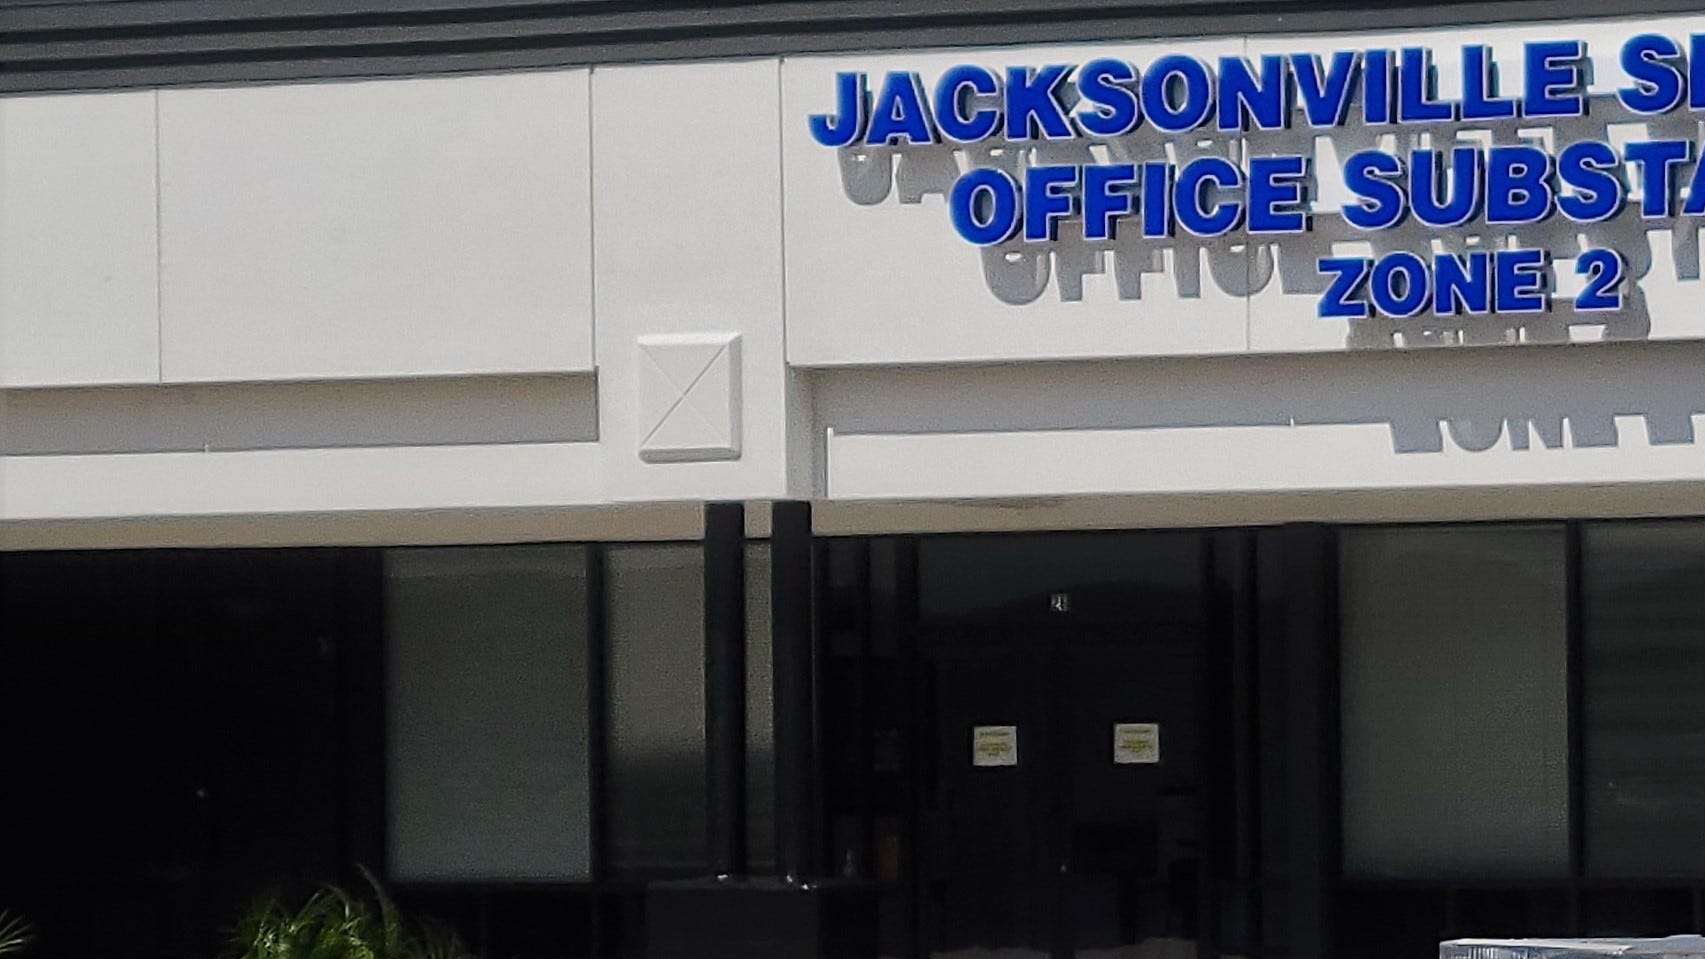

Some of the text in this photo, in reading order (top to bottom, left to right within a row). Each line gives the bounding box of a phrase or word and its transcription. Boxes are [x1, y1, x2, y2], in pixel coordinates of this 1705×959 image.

[810, 39, 1582, 148] JACKSONVILLE
[950, 156, 1305, 246] OFFICE
[1318, 249, 1622, 319] ZONE 2
